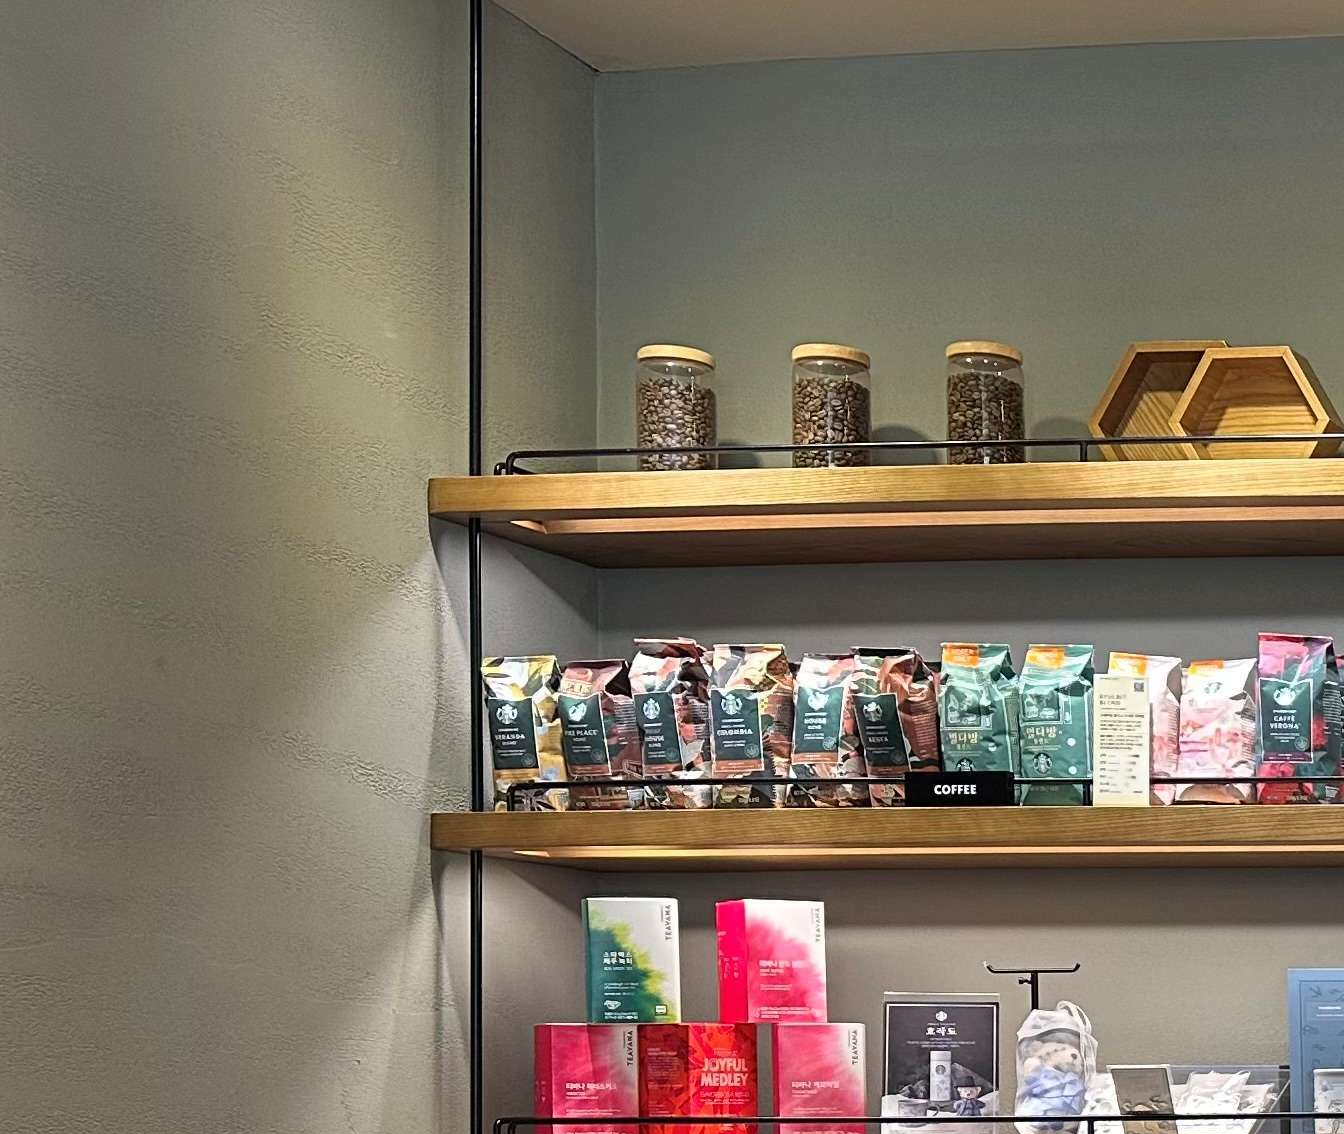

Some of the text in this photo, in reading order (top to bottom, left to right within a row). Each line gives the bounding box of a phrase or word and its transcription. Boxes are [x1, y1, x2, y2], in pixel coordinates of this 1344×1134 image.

[933, 784, 977, 796] COFFEE
[664, 904, 673, 941] TEAVANA
[626, 1029, 634, 1067] TEAVANA
[851, 1029, 859, 1066] TEAVANA
[702, 1057, 749, 1072] JOYFUL
[700, 1072, 749, 1087] MEDLEY
